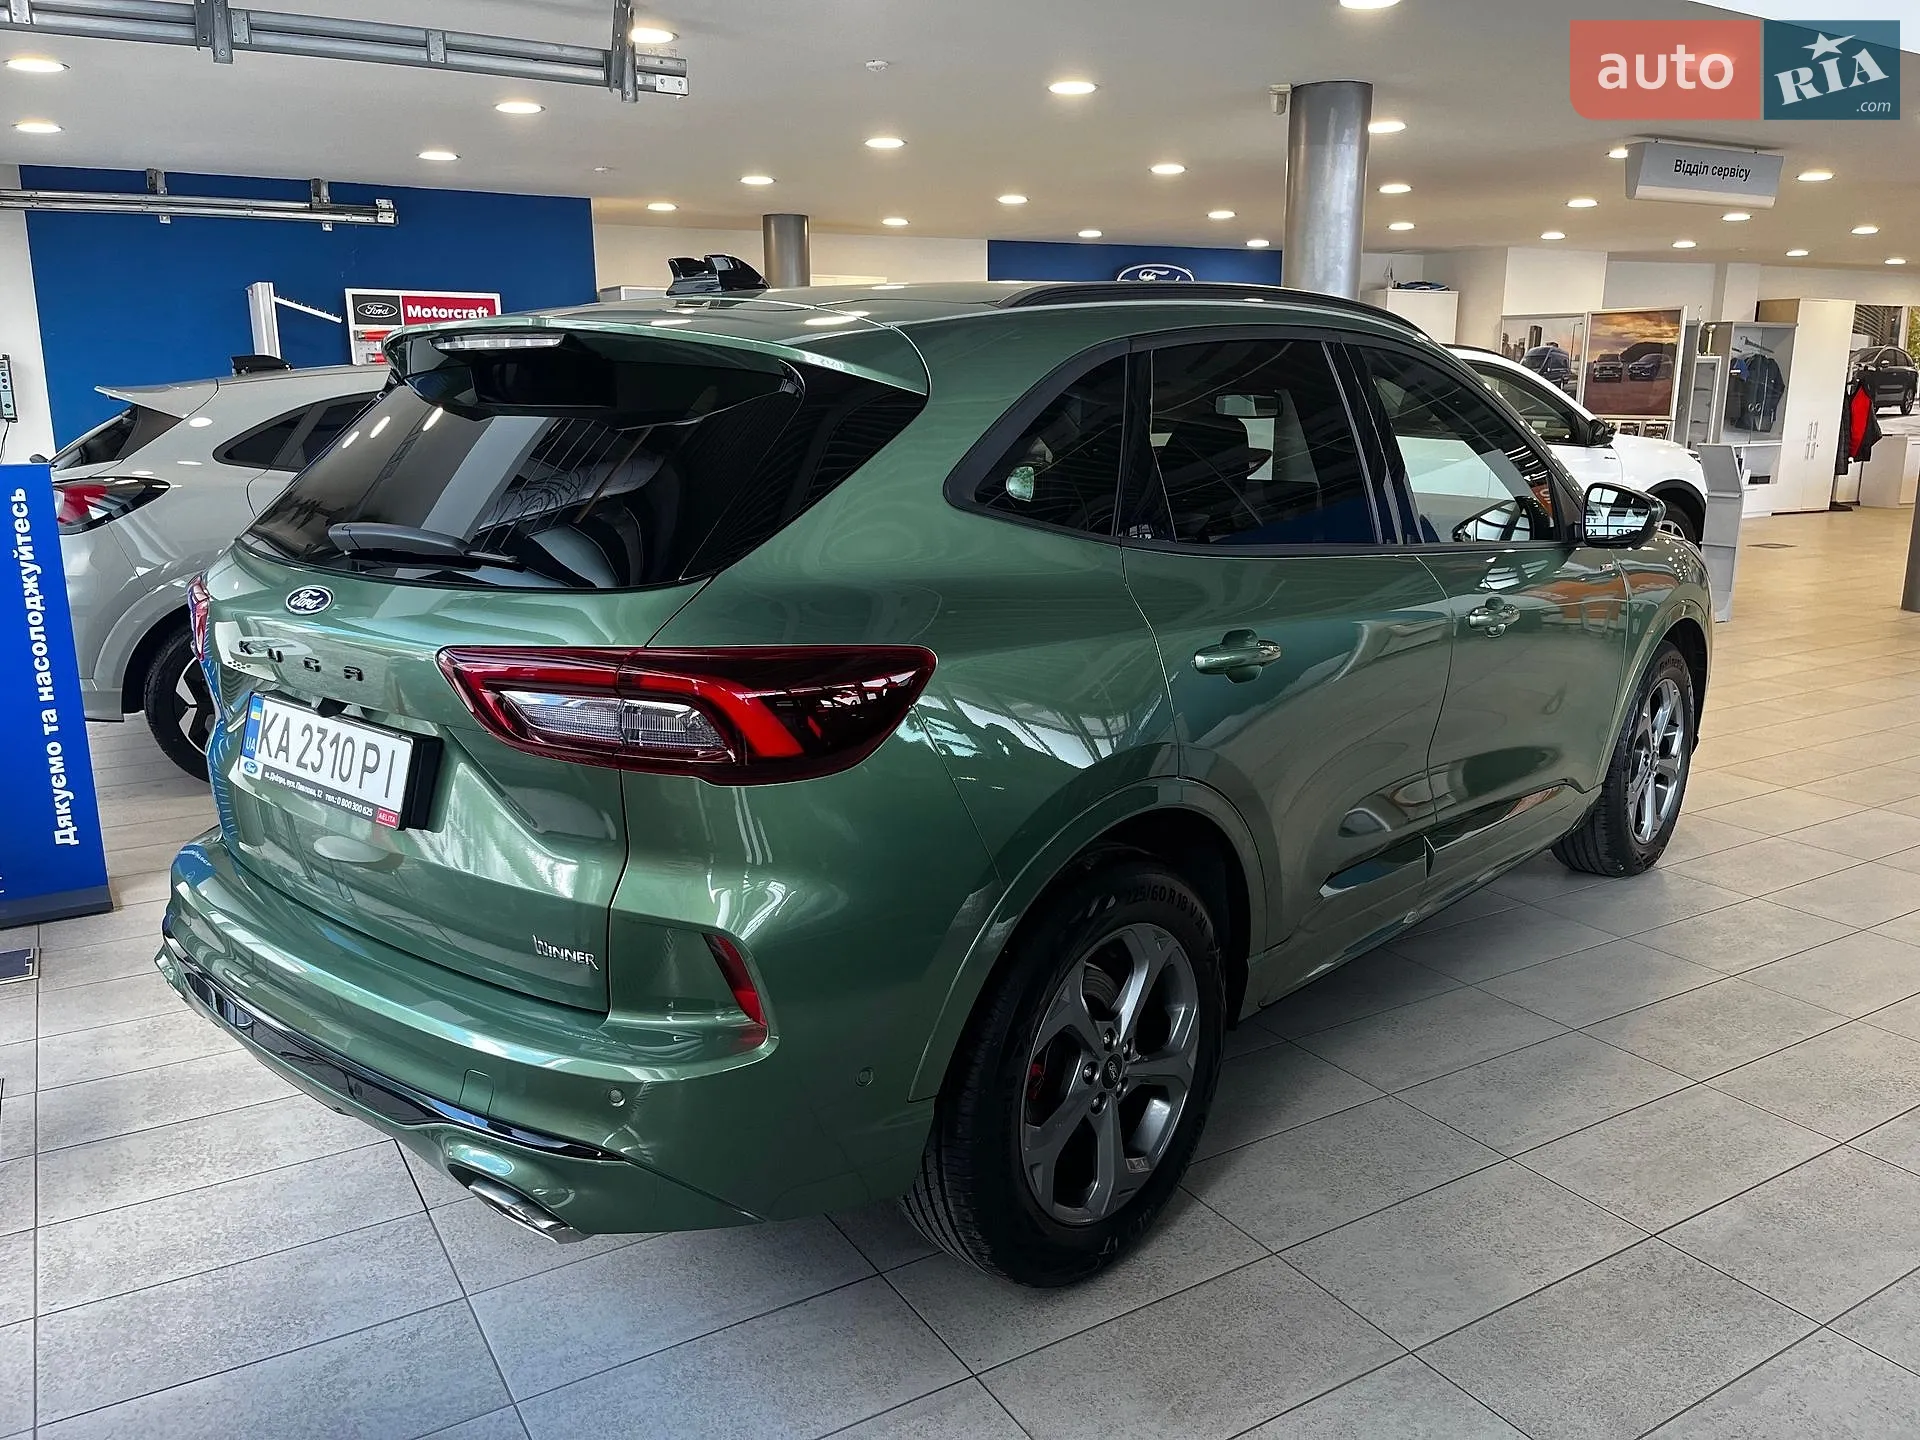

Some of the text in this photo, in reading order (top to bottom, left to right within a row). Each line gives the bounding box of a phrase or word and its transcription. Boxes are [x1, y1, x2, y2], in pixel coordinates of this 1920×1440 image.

[1674, 159, 1751, 182] Відділ сервісу
[365, 303, 390, 315] Ford
[407, 305, 489, 319] Motorcraft
[290, 589, 324, 610] Ford
[11, 487, 80, 846] Дякуємо та насолоджуйтесь
[238, 640, 364, 682] KUGA
[245, 736, 256, 751] UA
[296, 723, 355, 783] 2310
